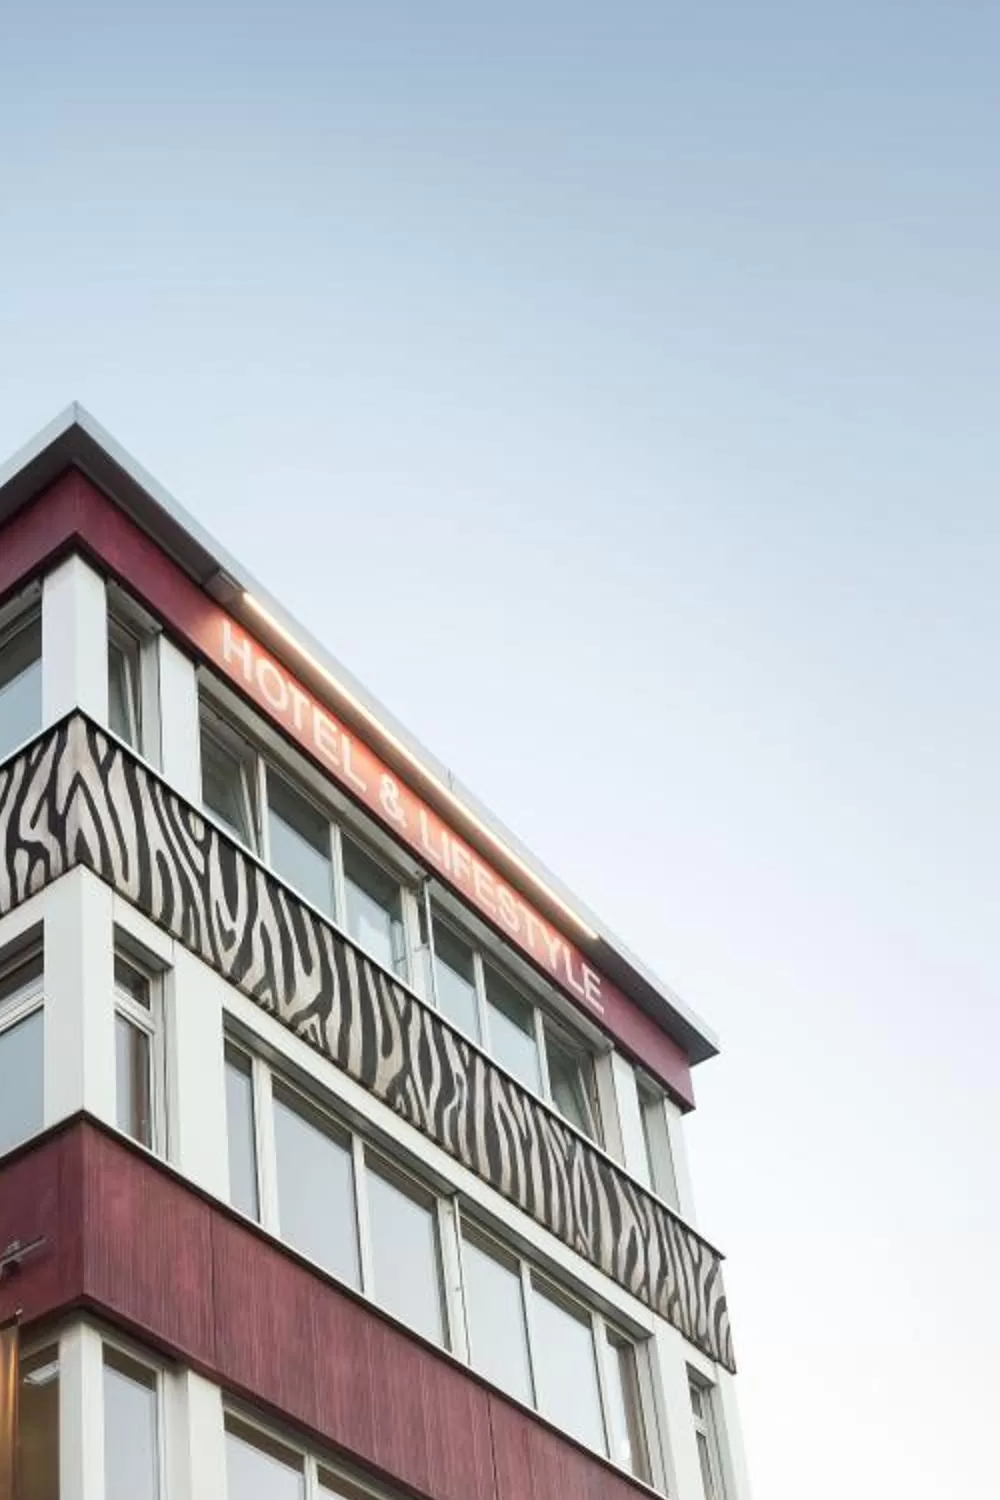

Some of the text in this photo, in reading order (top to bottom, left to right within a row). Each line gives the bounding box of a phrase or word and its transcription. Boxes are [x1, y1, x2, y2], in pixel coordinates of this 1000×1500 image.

[222, 618, 604, 1014] HOTEL & LIFESTYLE
